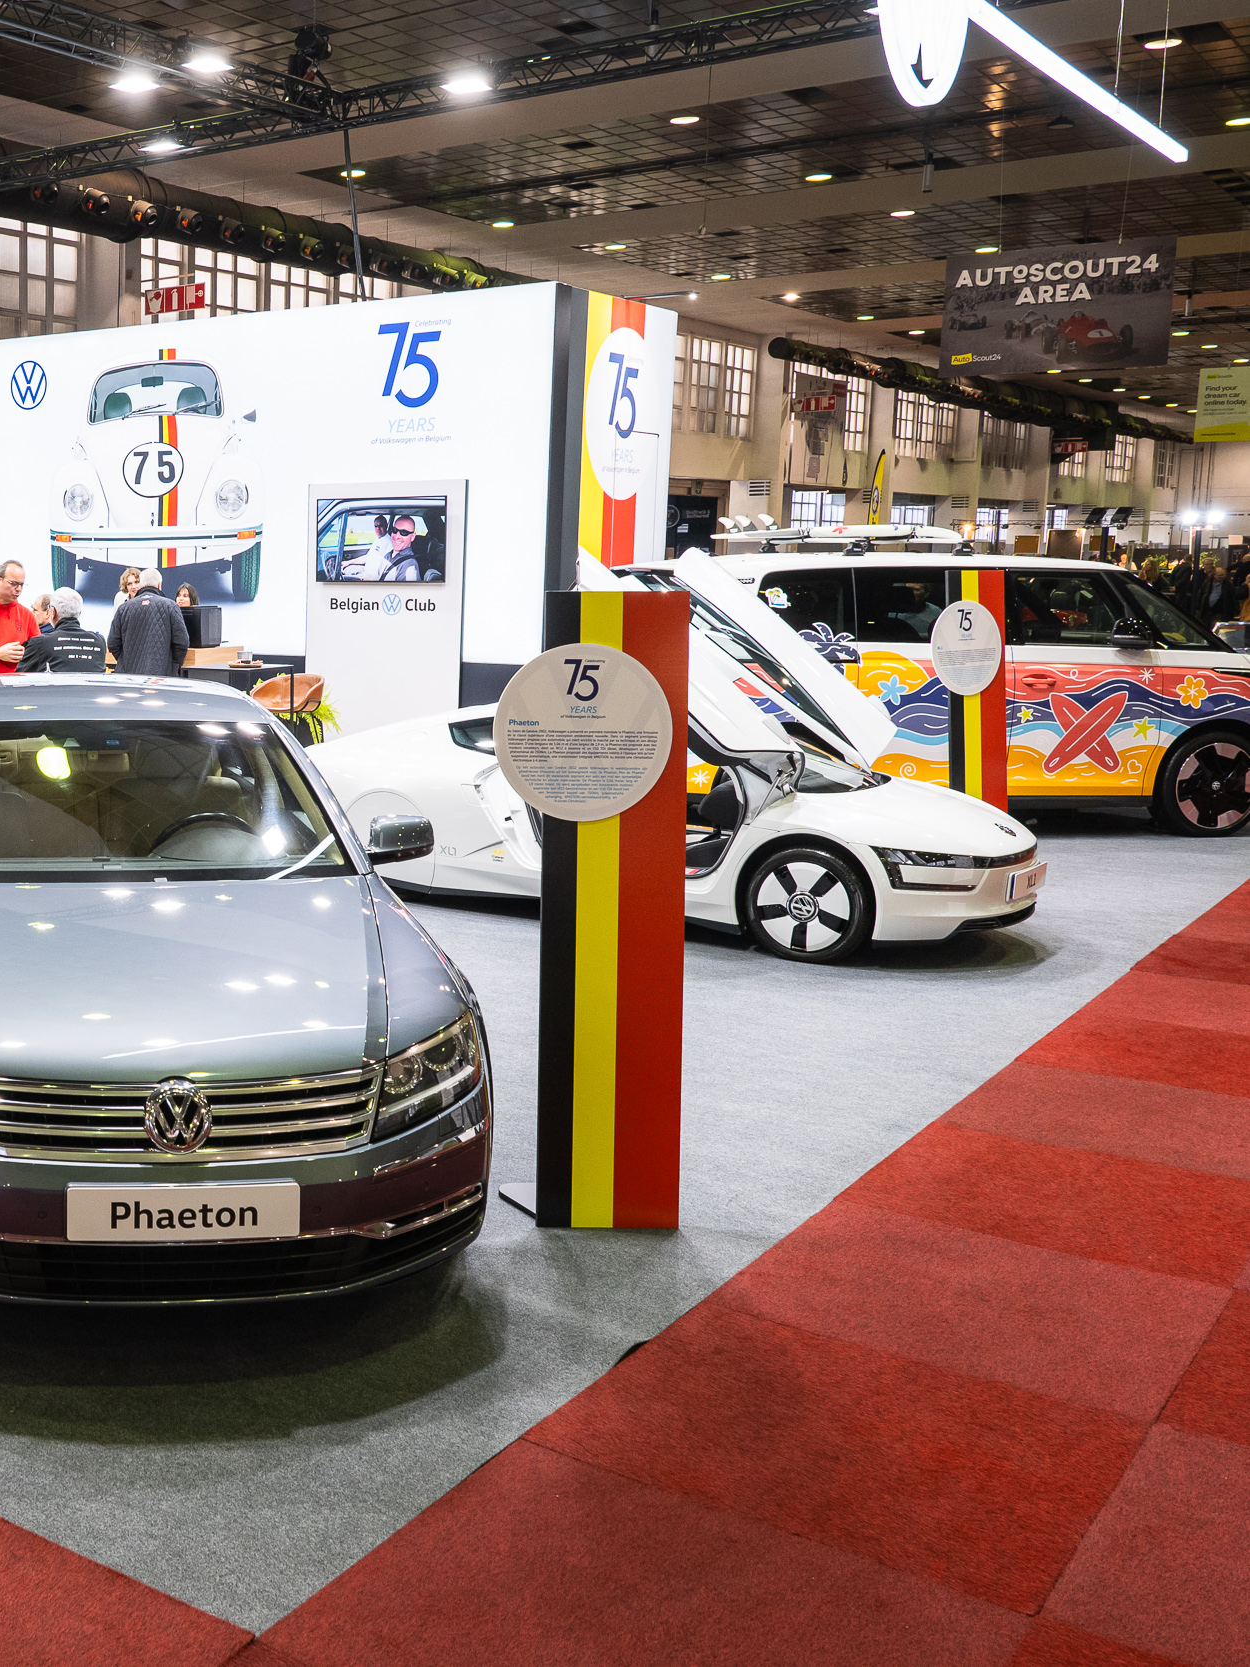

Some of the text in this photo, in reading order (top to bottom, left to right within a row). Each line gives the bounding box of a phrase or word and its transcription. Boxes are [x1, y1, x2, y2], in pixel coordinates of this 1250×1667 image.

[1015, 282, 1092, 306] AREA
[415, 318, 452, 327] Celebrating
[378, 322, 442, 408] 75
[609, 352, 638, 438] 75
[388, 417, 436, 434] YEARS
[379, 436, 416, 445] Volkswagen
[425, 435, 451, 444] Belgium
[134, 450, 176, 485] 75
[330, 598, 379, 613] Belgian
[405, 598, 436, 611] Club
[958, 609, 972, 631] 75
[564, 659, 600, 701] 75
[440, 845, 456, 856] XL1
[1026, 873, 1036, 889] XL1
[110, 1201, 258, 1230] Phaeton
